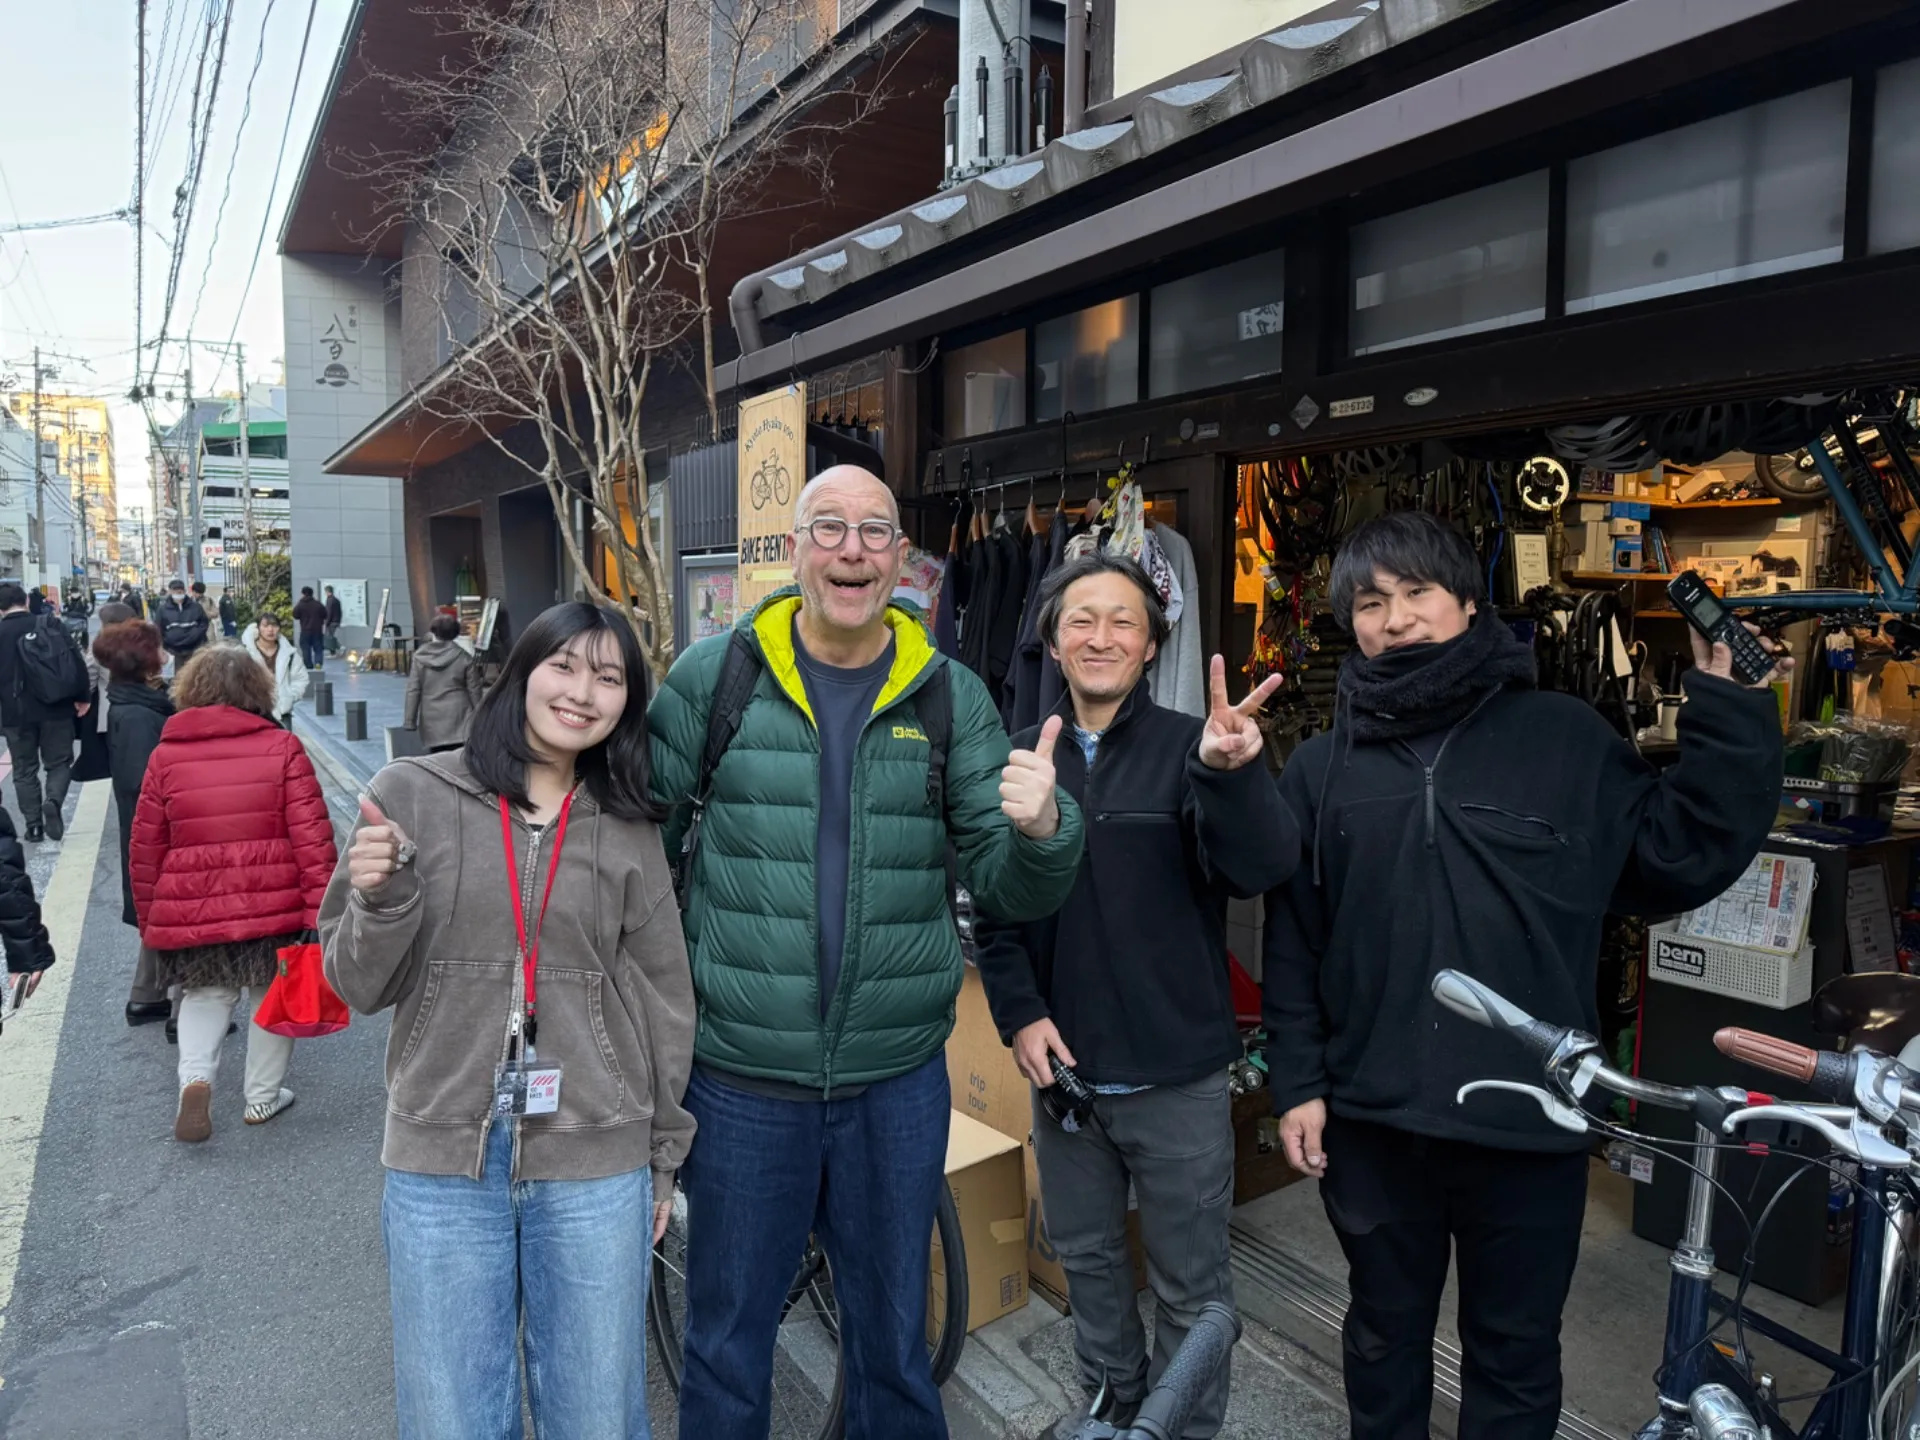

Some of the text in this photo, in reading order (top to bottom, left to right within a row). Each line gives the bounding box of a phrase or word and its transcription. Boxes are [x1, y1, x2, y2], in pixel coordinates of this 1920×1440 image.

[741, 533, 788, 564] BIKE RENT
[1660, 942, 1703, 966] bern
[970, 1071, 986, 1094] trip
[968, 1091, 988, 1114] tour
